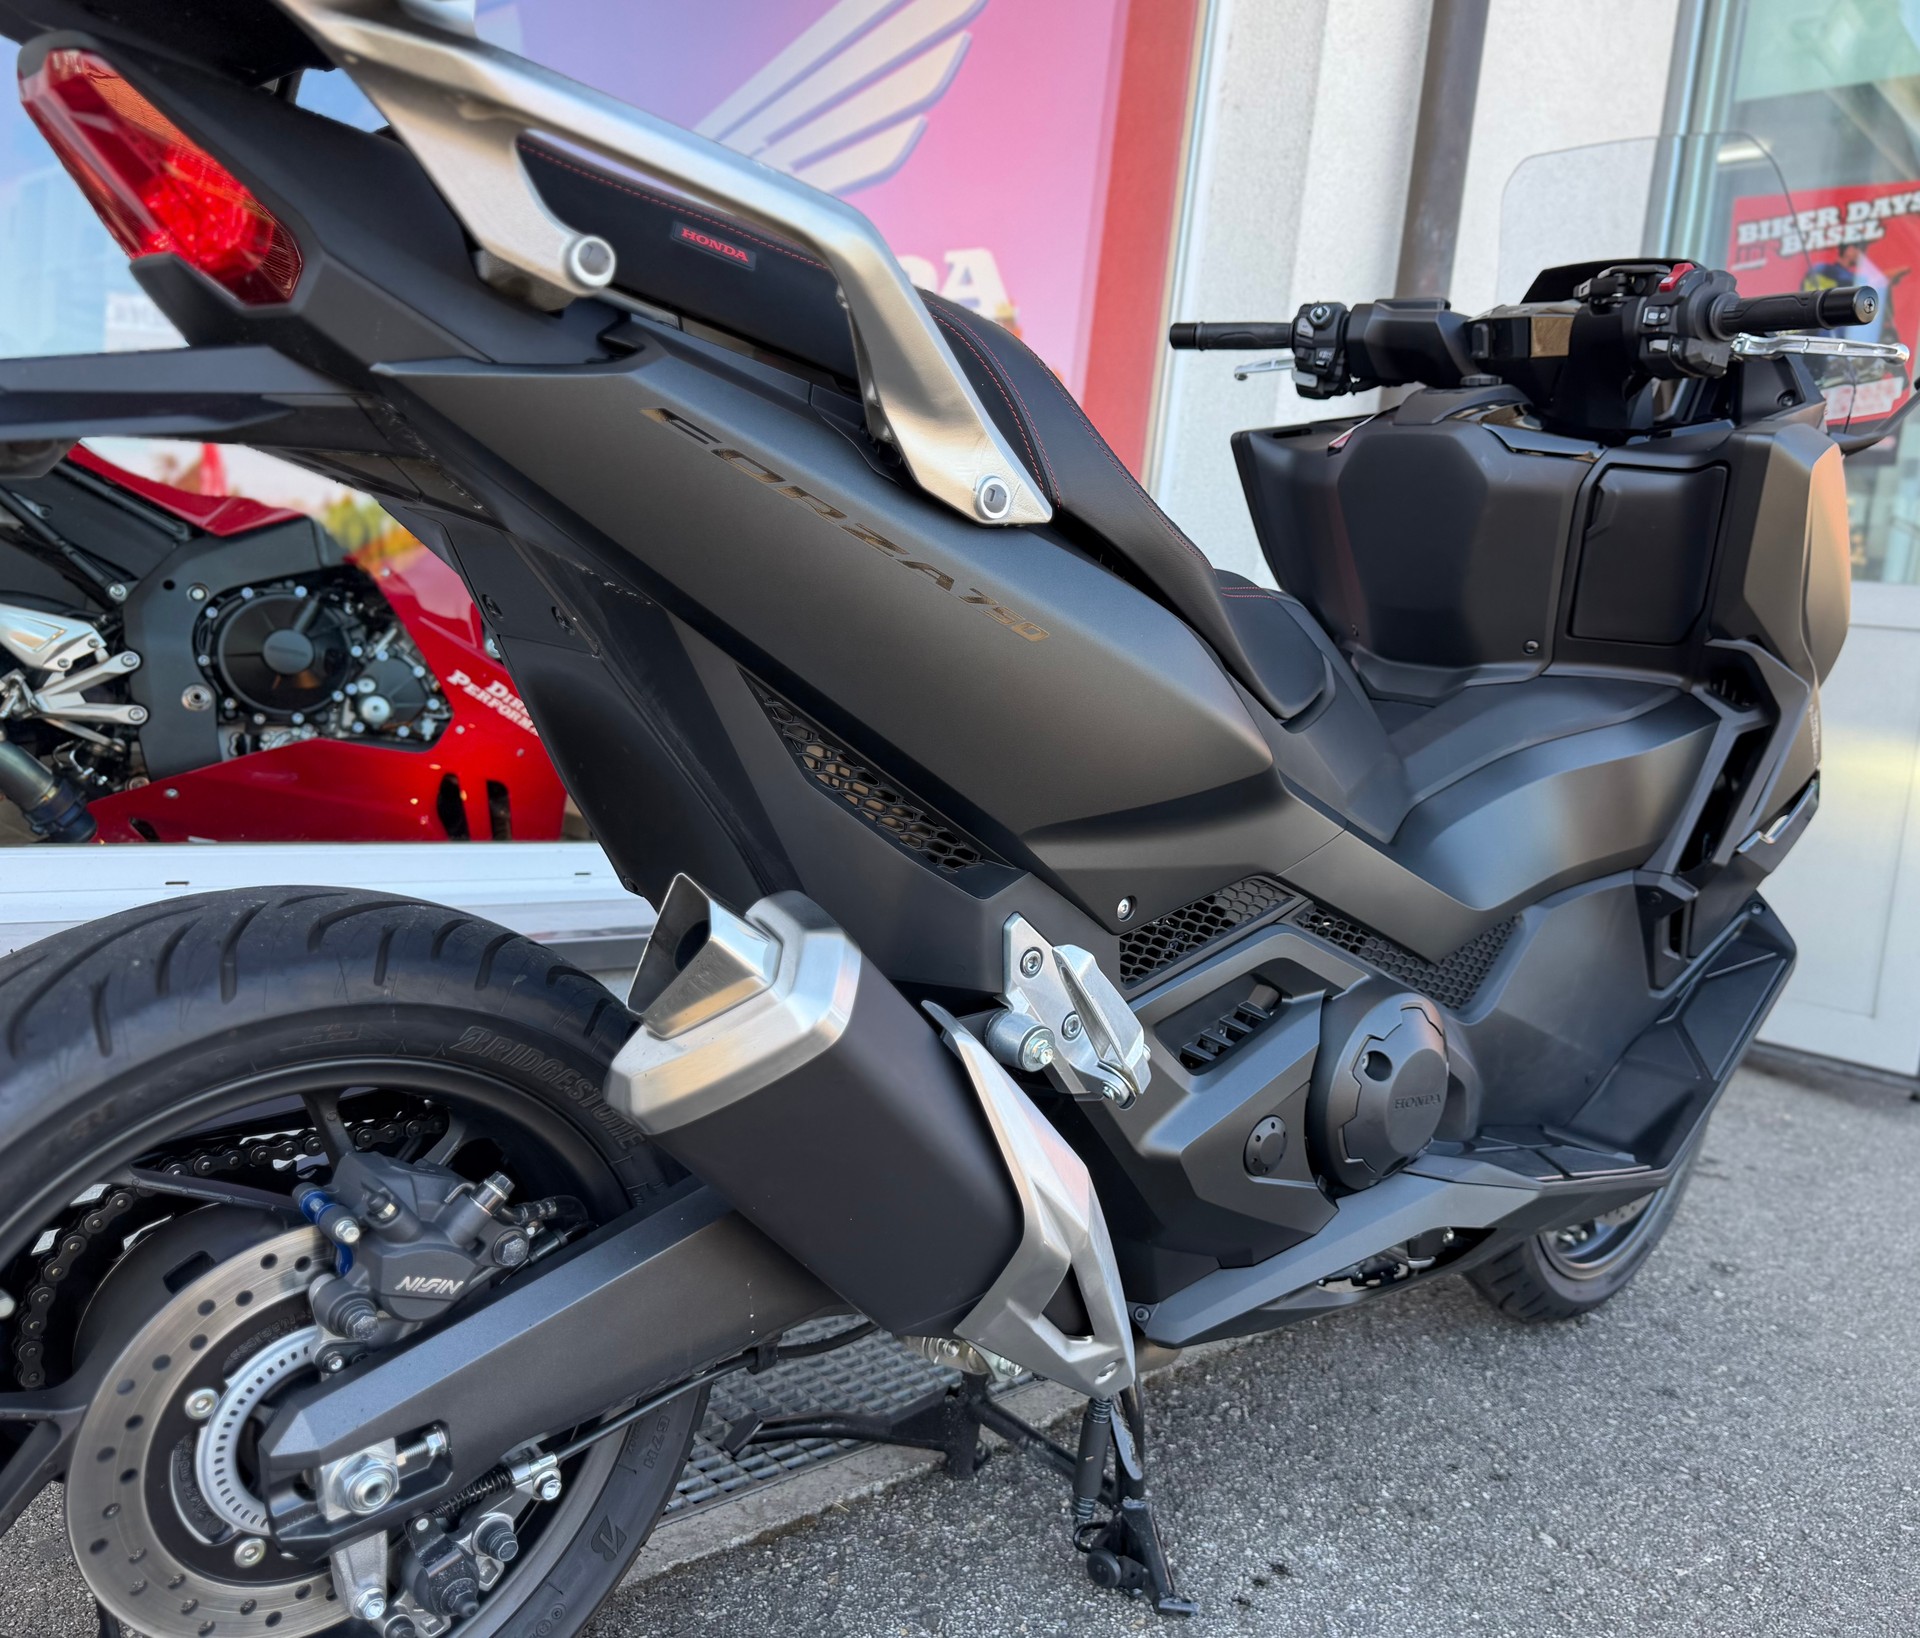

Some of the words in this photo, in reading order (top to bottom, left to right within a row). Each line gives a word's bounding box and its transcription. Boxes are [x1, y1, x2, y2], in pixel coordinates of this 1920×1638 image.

[1737, 206, 1841, 245] BIKER
[1780, 220, 1885, 257] BASEL
[681, 227, 749, 263] HONDA
[640, 407, 955, 591] FORZA
[959, 587, 1050, 642] 750
[1393, 1093, 1442, 1110] HONDA
